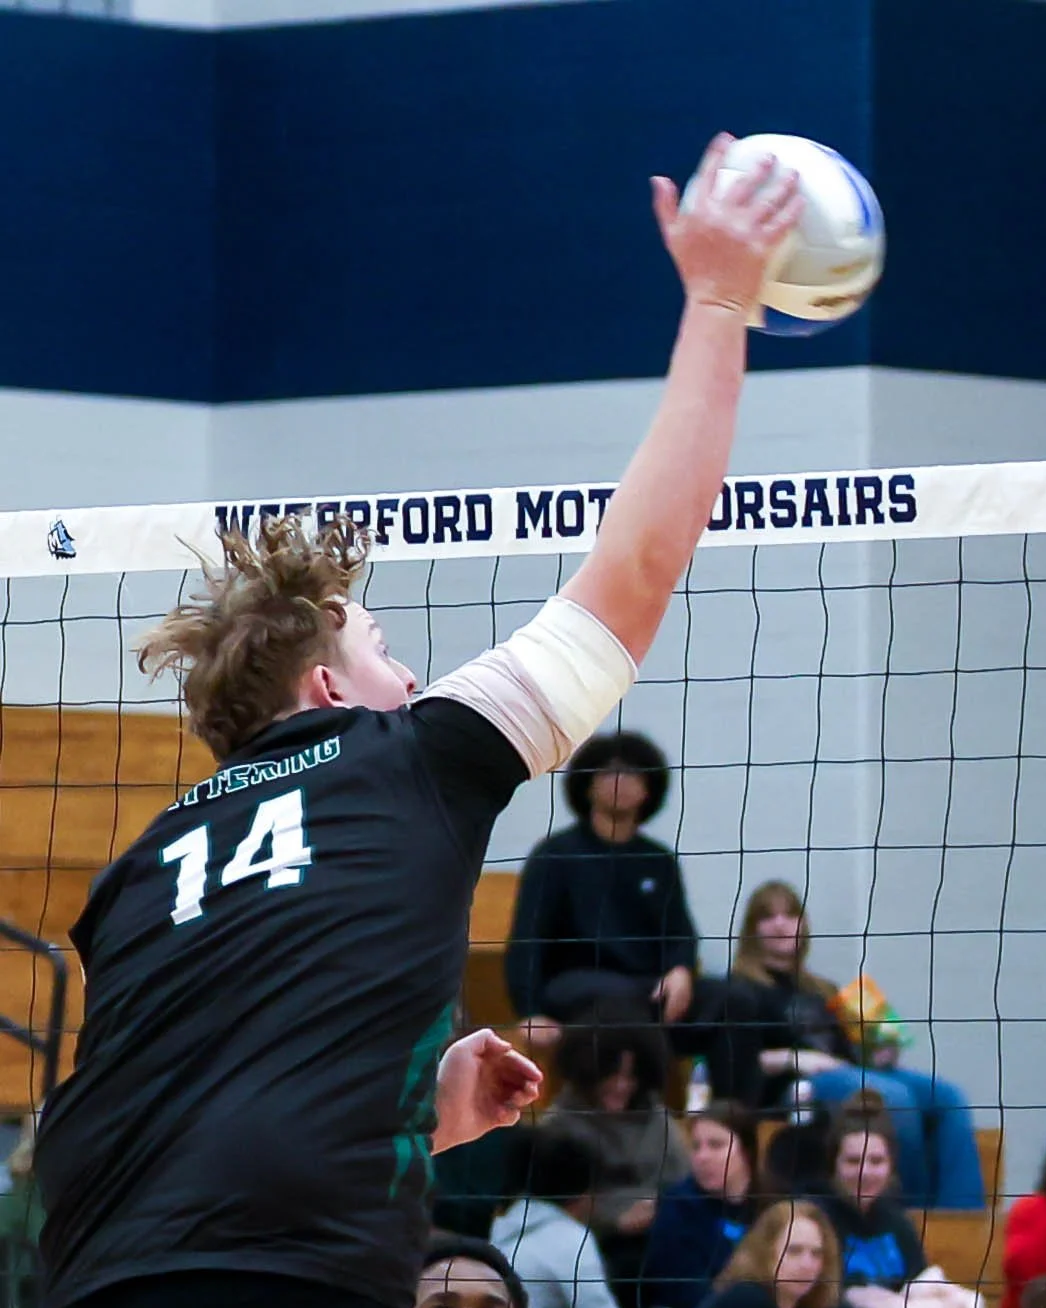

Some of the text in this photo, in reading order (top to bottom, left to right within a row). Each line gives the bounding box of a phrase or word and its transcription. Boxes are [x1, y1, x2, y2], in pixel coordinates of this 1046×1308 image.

[515, 488, 620, 539] MOT
[706, 474, 918, 532] ORSAIRS
[160, 787, 316, 926] 14
